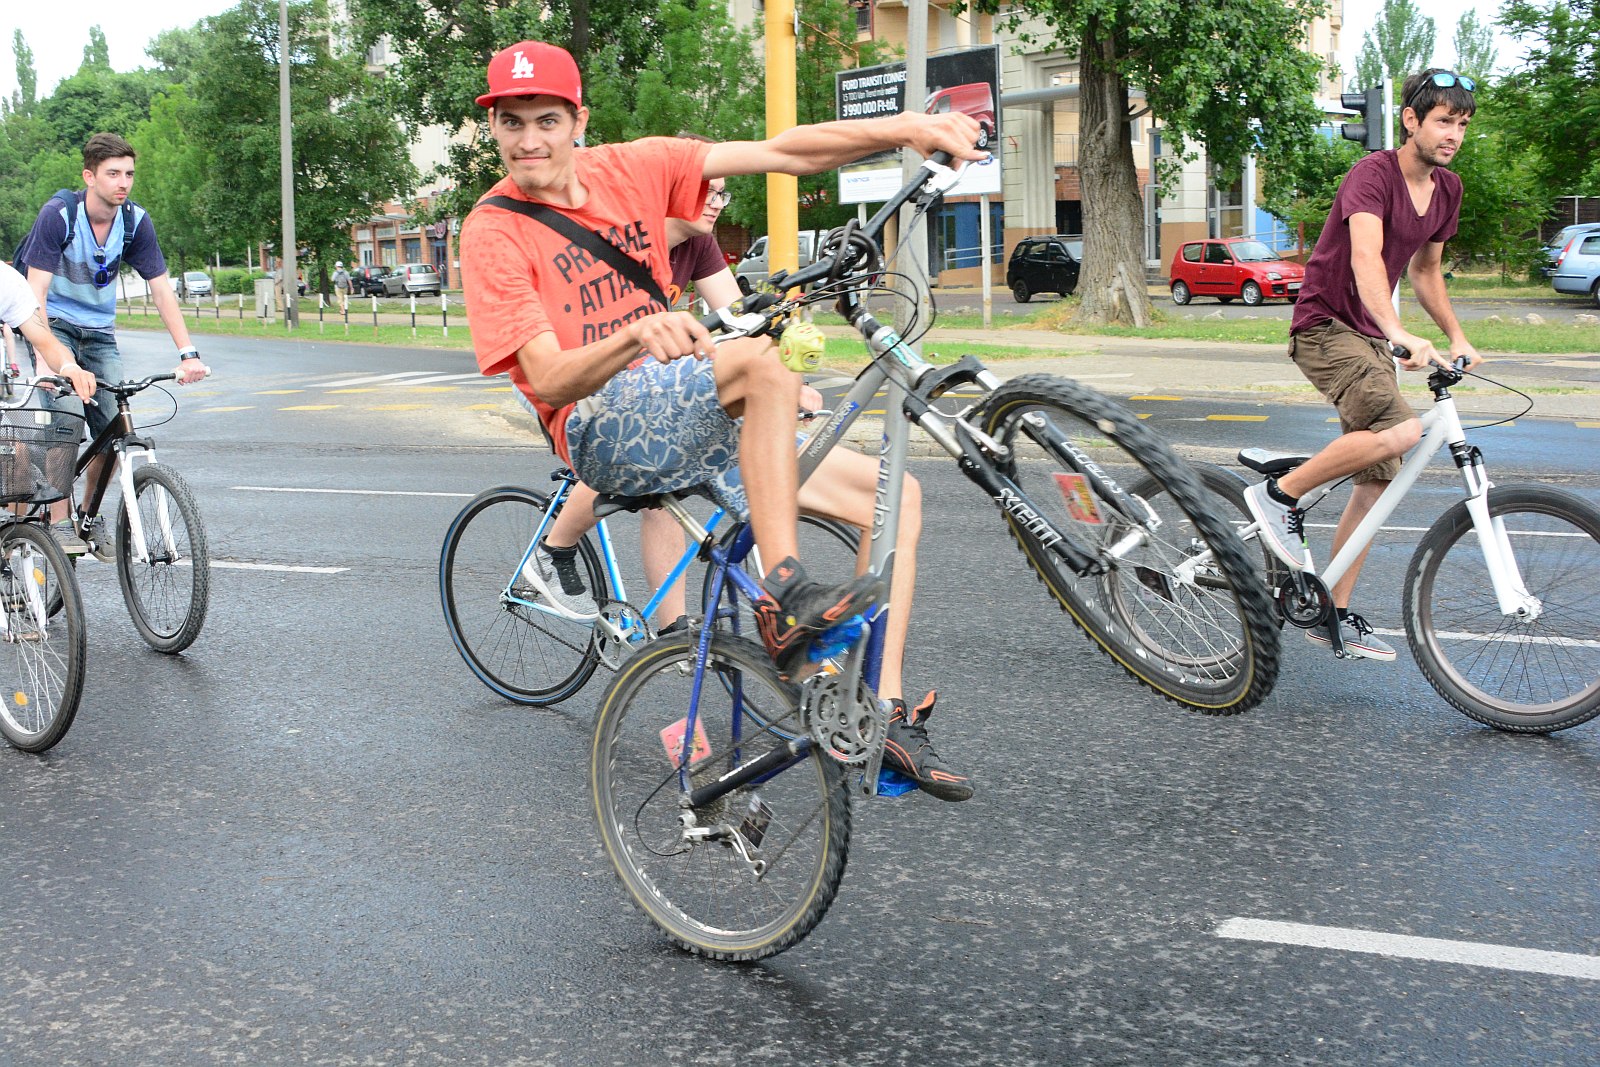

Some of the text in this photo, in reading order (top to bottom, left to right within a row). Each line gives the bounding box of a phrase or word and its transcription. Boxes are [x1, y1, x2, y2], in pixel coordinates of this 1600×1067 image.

[511, 51, 534, 79] LA
[842, 71, 907, 91] FORD TRANSIT CONNEC
[862, 100, 876, 114] 000
[808, 401, 855, 458] HIGHLANDER
